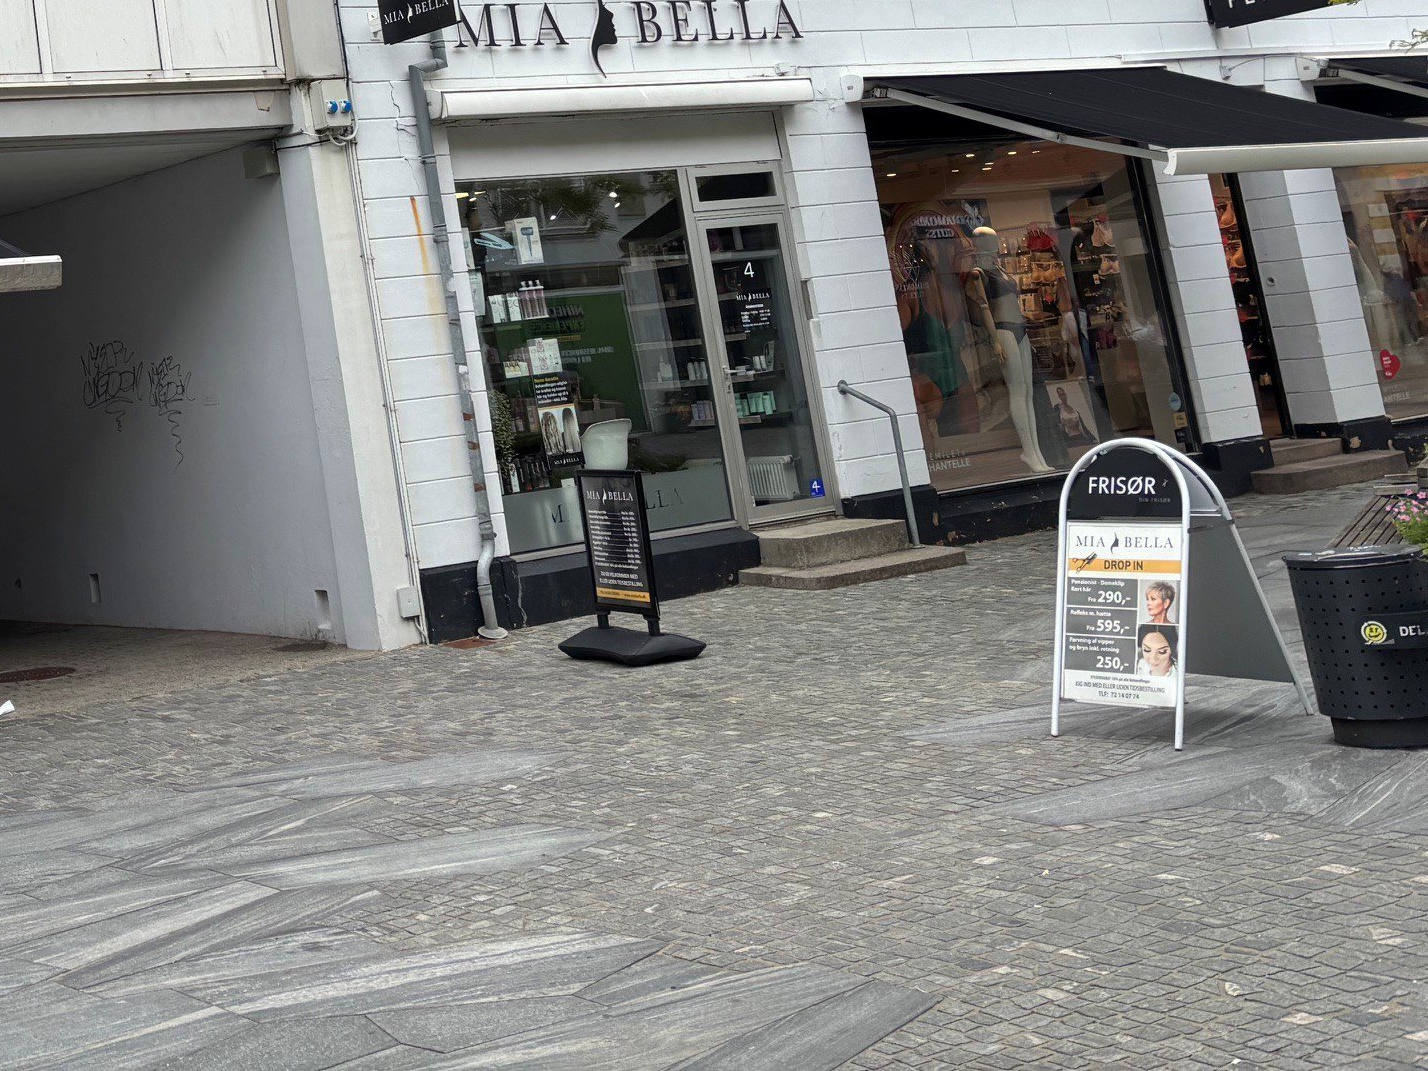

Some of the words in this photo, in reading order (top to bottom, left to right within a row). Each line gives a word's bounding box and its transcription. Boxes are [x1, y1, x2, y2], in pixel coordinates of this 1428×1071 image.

[384, 9, 404, 24] MIA
[455, 2, 569, 48] MIA
[744, 262, 754, 277] 4
[929, 458, 971, 472] HANTELLE
[812, 481, 821, 492] 4
[1088, 476, 1156, 495] FRISØR
[586, 491, 600, 500] MIA
[608, 491, 633, 501] BELLA
[1076, 536, 1105, 547] MIA
[1124, 537, 1173, 548] BELLA
[1104, 561, 1130, 570] DROP
[1134, 561, 1143, 570] IN
[1098, 591, 1131, 605] 290,-
[1096, 619, 1130, 634] 595,-
[1096, 656, 1129, 671] 250,-
